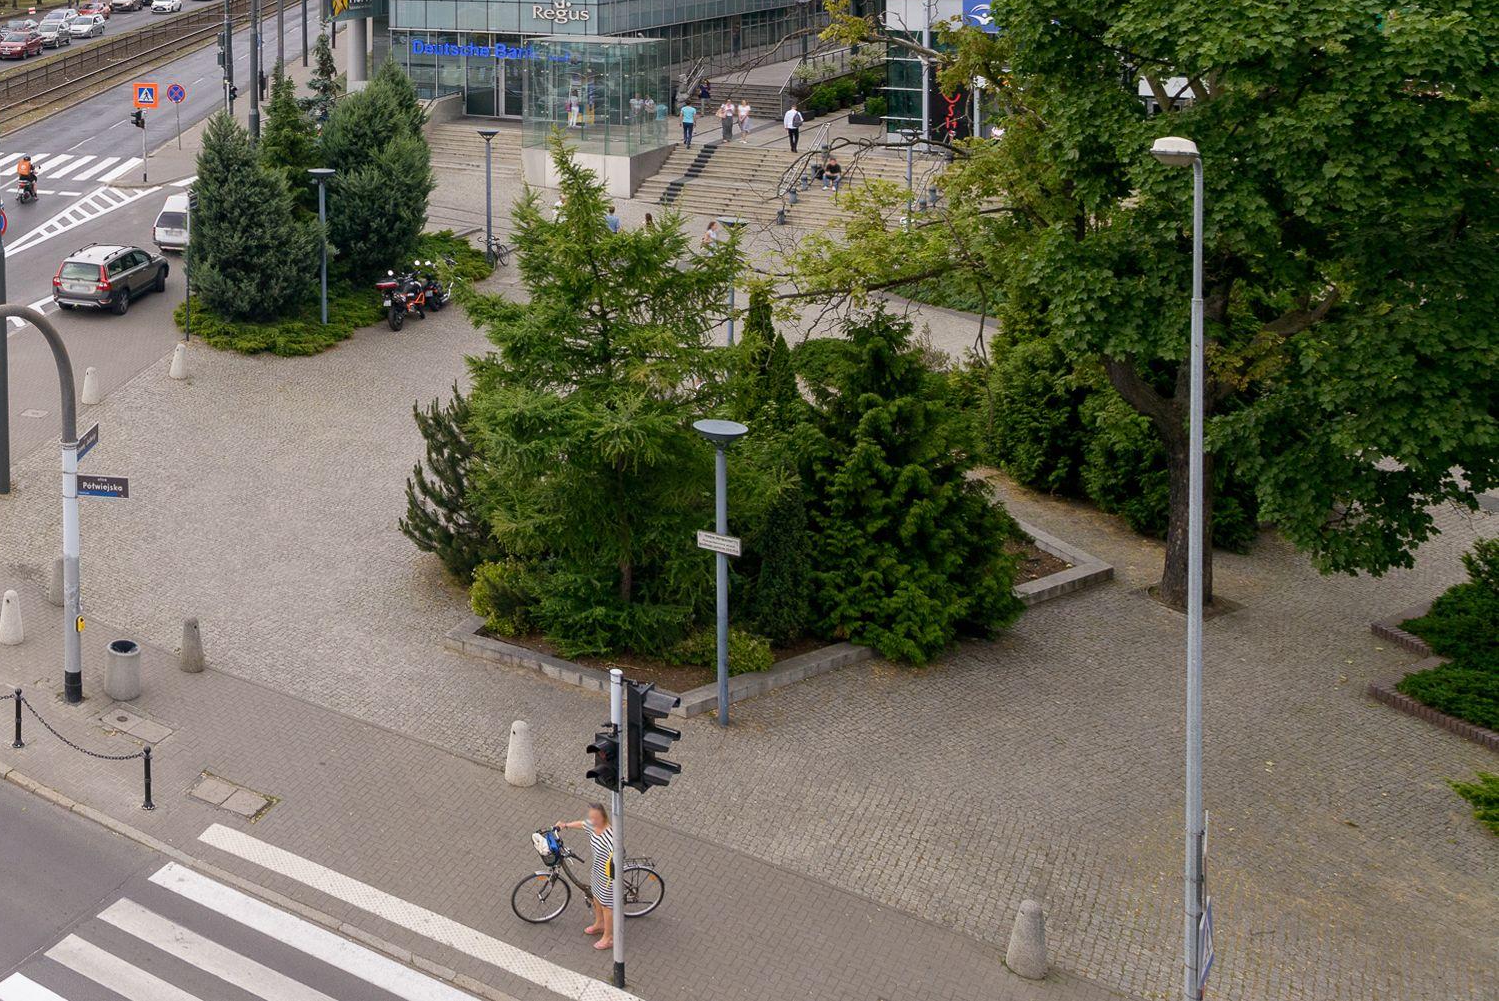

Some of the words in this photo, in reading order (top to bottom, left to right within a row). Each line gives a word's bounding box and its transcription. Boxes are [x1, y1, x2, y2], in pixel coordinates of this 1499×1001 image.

[532, 4, 590, 24] Regus
[412, 39, 490, 58] Deutsche
[82, 481, 123, 493] Półwiejska
